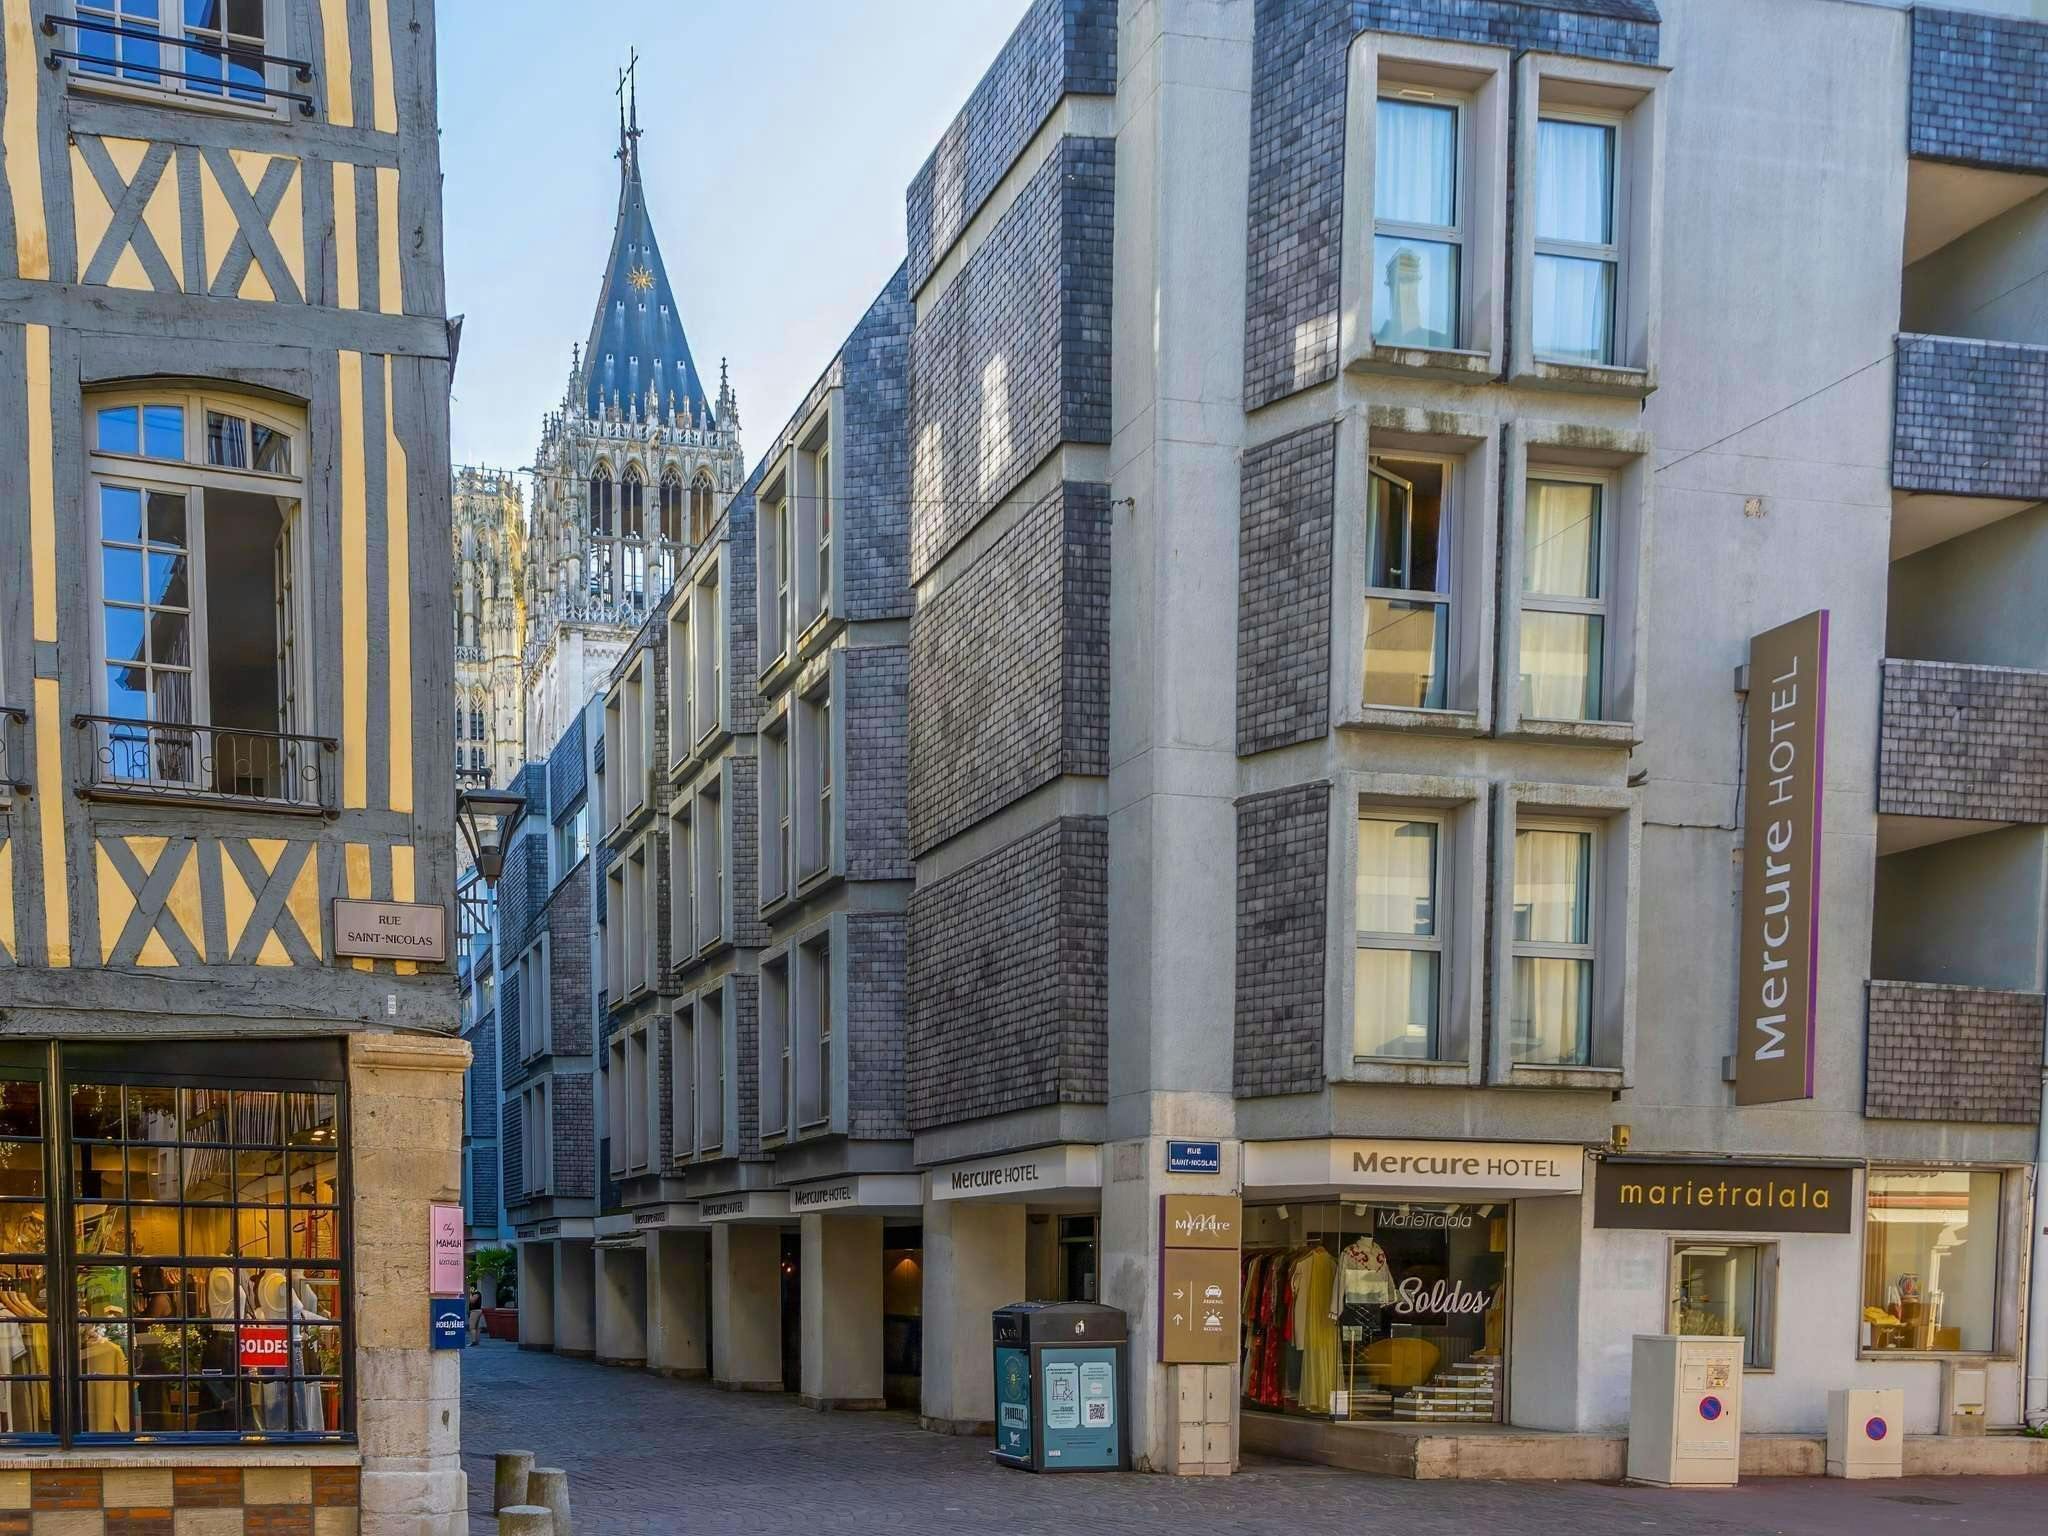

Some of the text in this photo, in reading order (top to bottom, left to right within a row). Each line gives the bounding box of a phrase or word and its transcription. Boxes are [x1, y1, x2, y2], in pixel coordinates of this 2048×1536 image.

[1755, 655, 1798, 1061] Mercure HOTEL
[378, 915, 402, 926] RUE
[348, 932, 433, 946] SAINT-NICOLAS
[1187, 1147, 1202, 1155] RUE
[1353, 1151, 1560, 1178] Mercure HOTEL
[951, 1164, 1039, 1190] Mercure HOTEL
[795, 1186, 852, 1206] Mercure HOTEL
[1620, 1180, 1830, 1208] marietralala
[1175, 1218, 1230, 1231] Mercure
[1378, 1212, 1473, 1228] MarieTralala
[1395, 1276, 1490, 1314] Soldes
[240, 1339, 288, 1354] SOLDES
